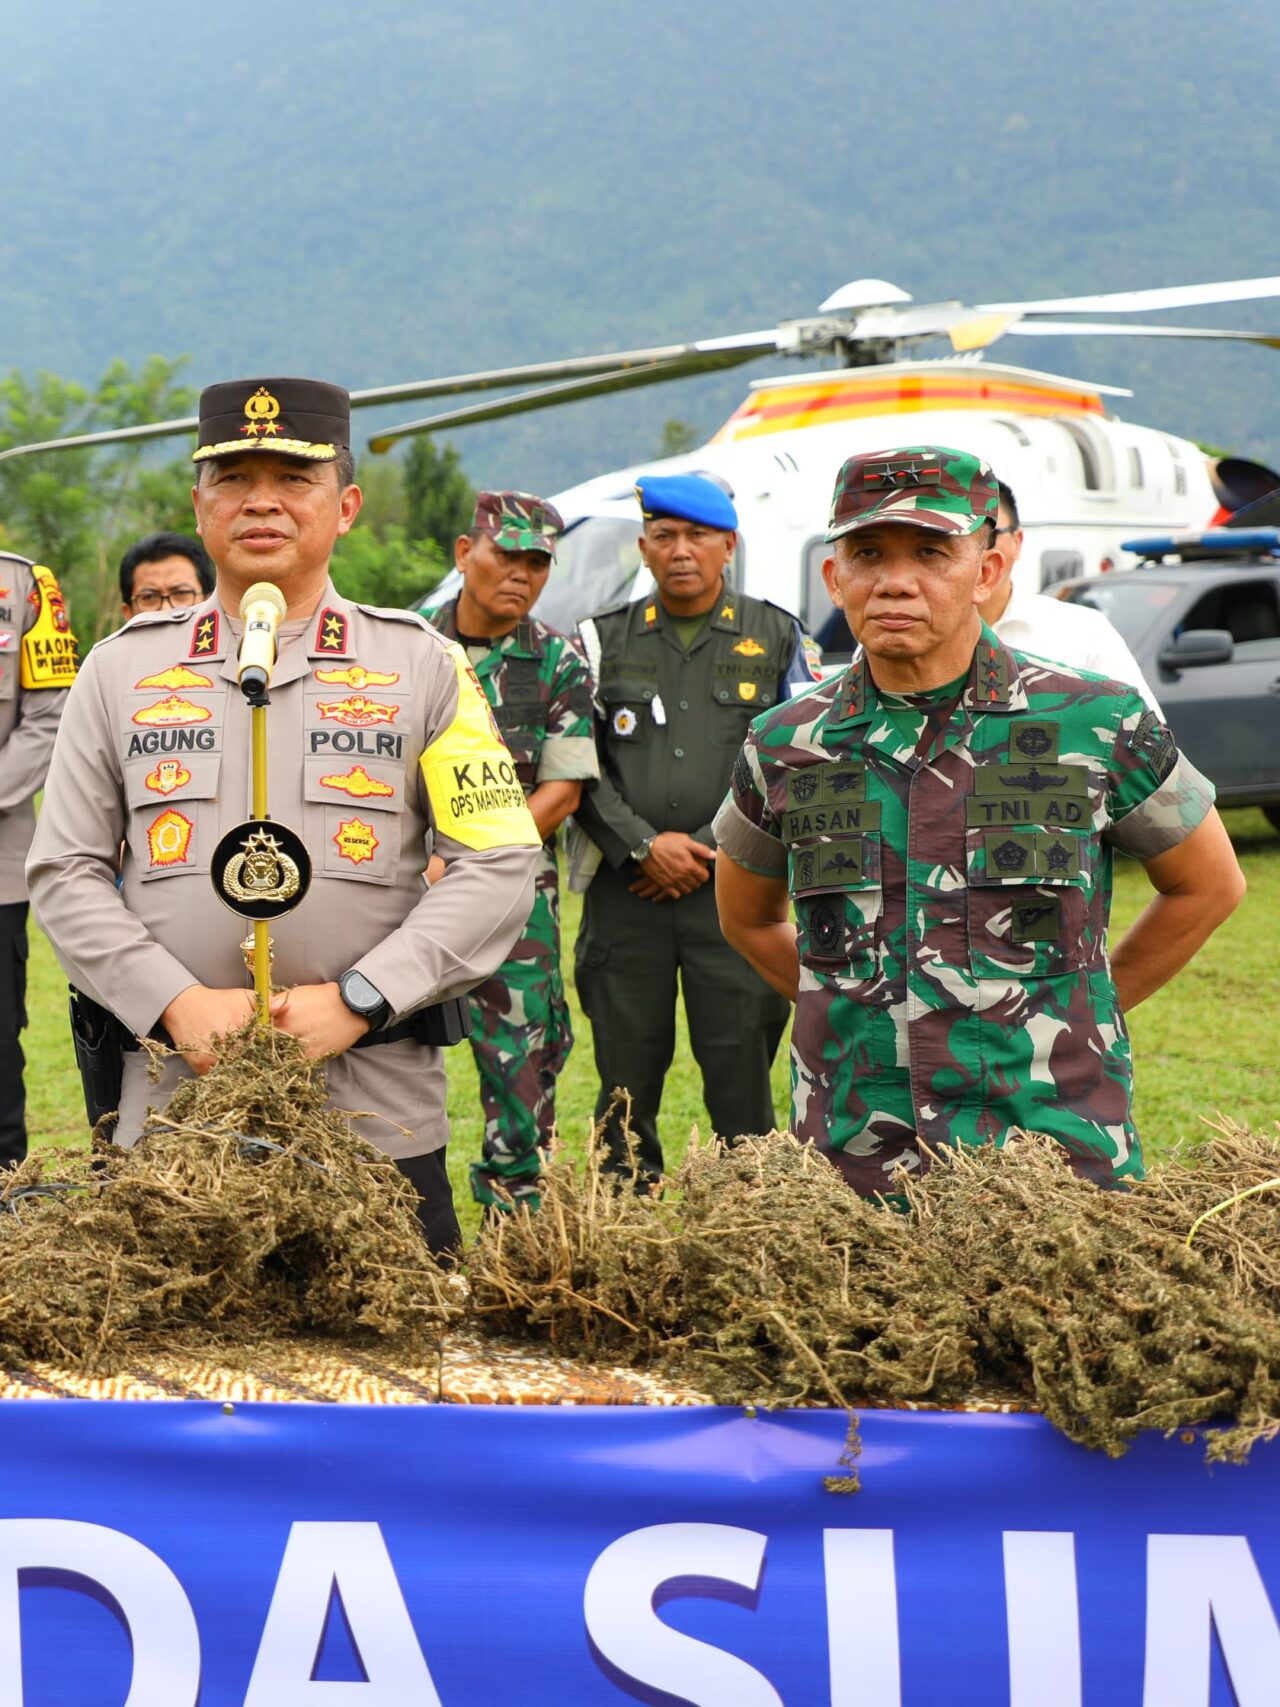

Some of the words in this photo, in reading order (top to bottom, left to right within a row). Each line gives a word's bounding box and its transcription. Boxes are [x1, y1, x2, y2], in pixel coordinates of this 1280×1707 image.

[128, 729, 215, 757] AGUNG
[311, 730, 403, 759] POLRI
[451, 793, 474, 818] OPS
[979, 799, 1030, 821] TNI
[1045, 801, 1082, 822] AD
[789, 807, 861, 837] HASAN
